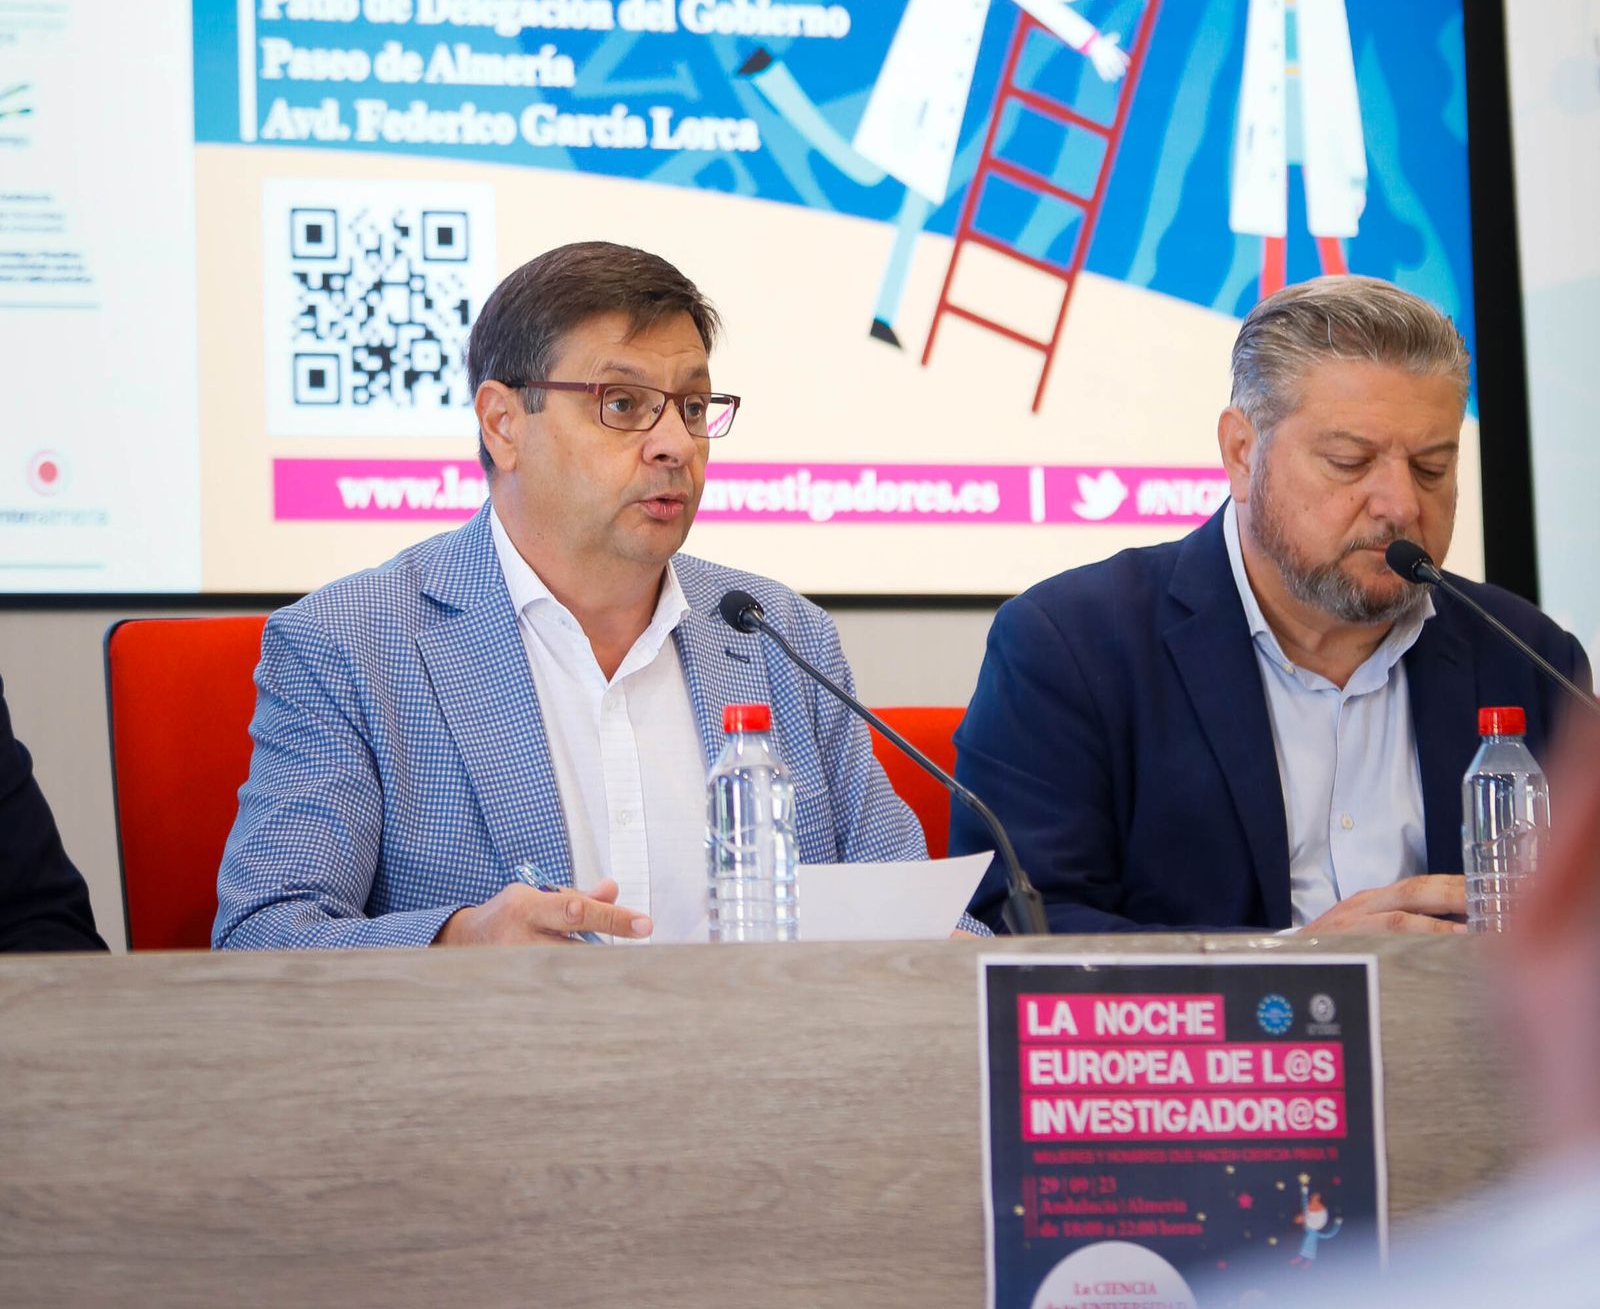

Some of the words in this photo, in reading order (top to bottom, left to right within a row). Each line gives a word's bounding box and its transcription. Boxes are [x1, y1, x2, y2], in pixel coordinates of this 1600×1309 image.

[260, 37, 369, 82] Paseo
[375, 41, 421, 83] de
[424, 43, 576, 89] Almería
[261, 97, 350, 141] Avd.
[354, 100, 517, 146] Federico
[520, 104, 646, 149] García
[649, 108, 760, 152] Lorca
[337, 465, 489, 509] www.la
[1027, 1001, 1078, 1035] LA
[1095, 1001, 1216, 1035] NOCHE
[1029, 1050, 1193, 1085] EUROPEA
[1207, 1050, 1252, 1083] DE
[1263, 1049, 1336, 1083] L@S
[1030, 1098, 1338, 1134] INVESTIGADOR@S
